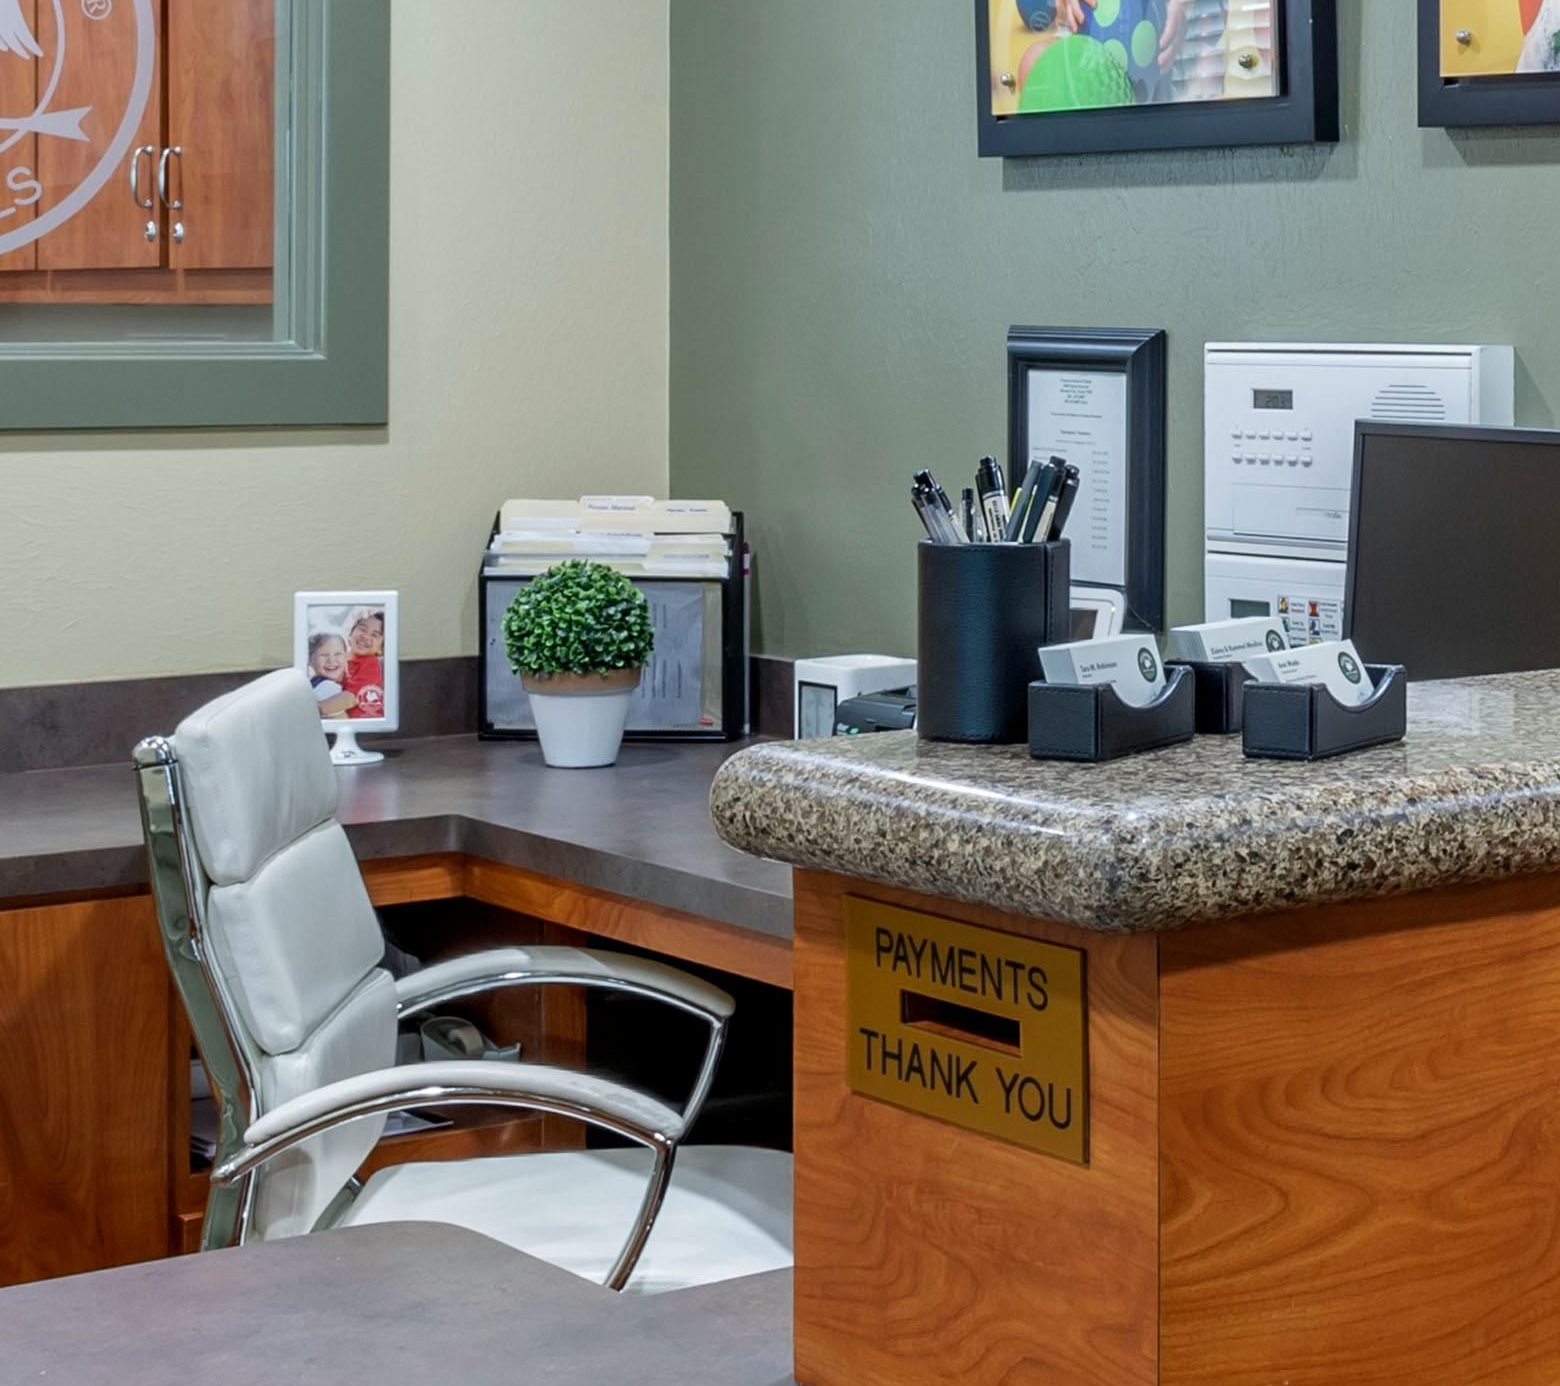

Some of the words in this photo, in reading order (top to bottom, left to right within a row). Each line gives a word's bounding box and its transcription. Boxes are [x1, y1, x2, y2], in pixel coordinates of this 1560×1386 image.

[875, 927, 1048, 1011] PAYMENTS
[859, 1027, 979, 1105] THANK
[995, 1067, 1072, 1130] YOU
